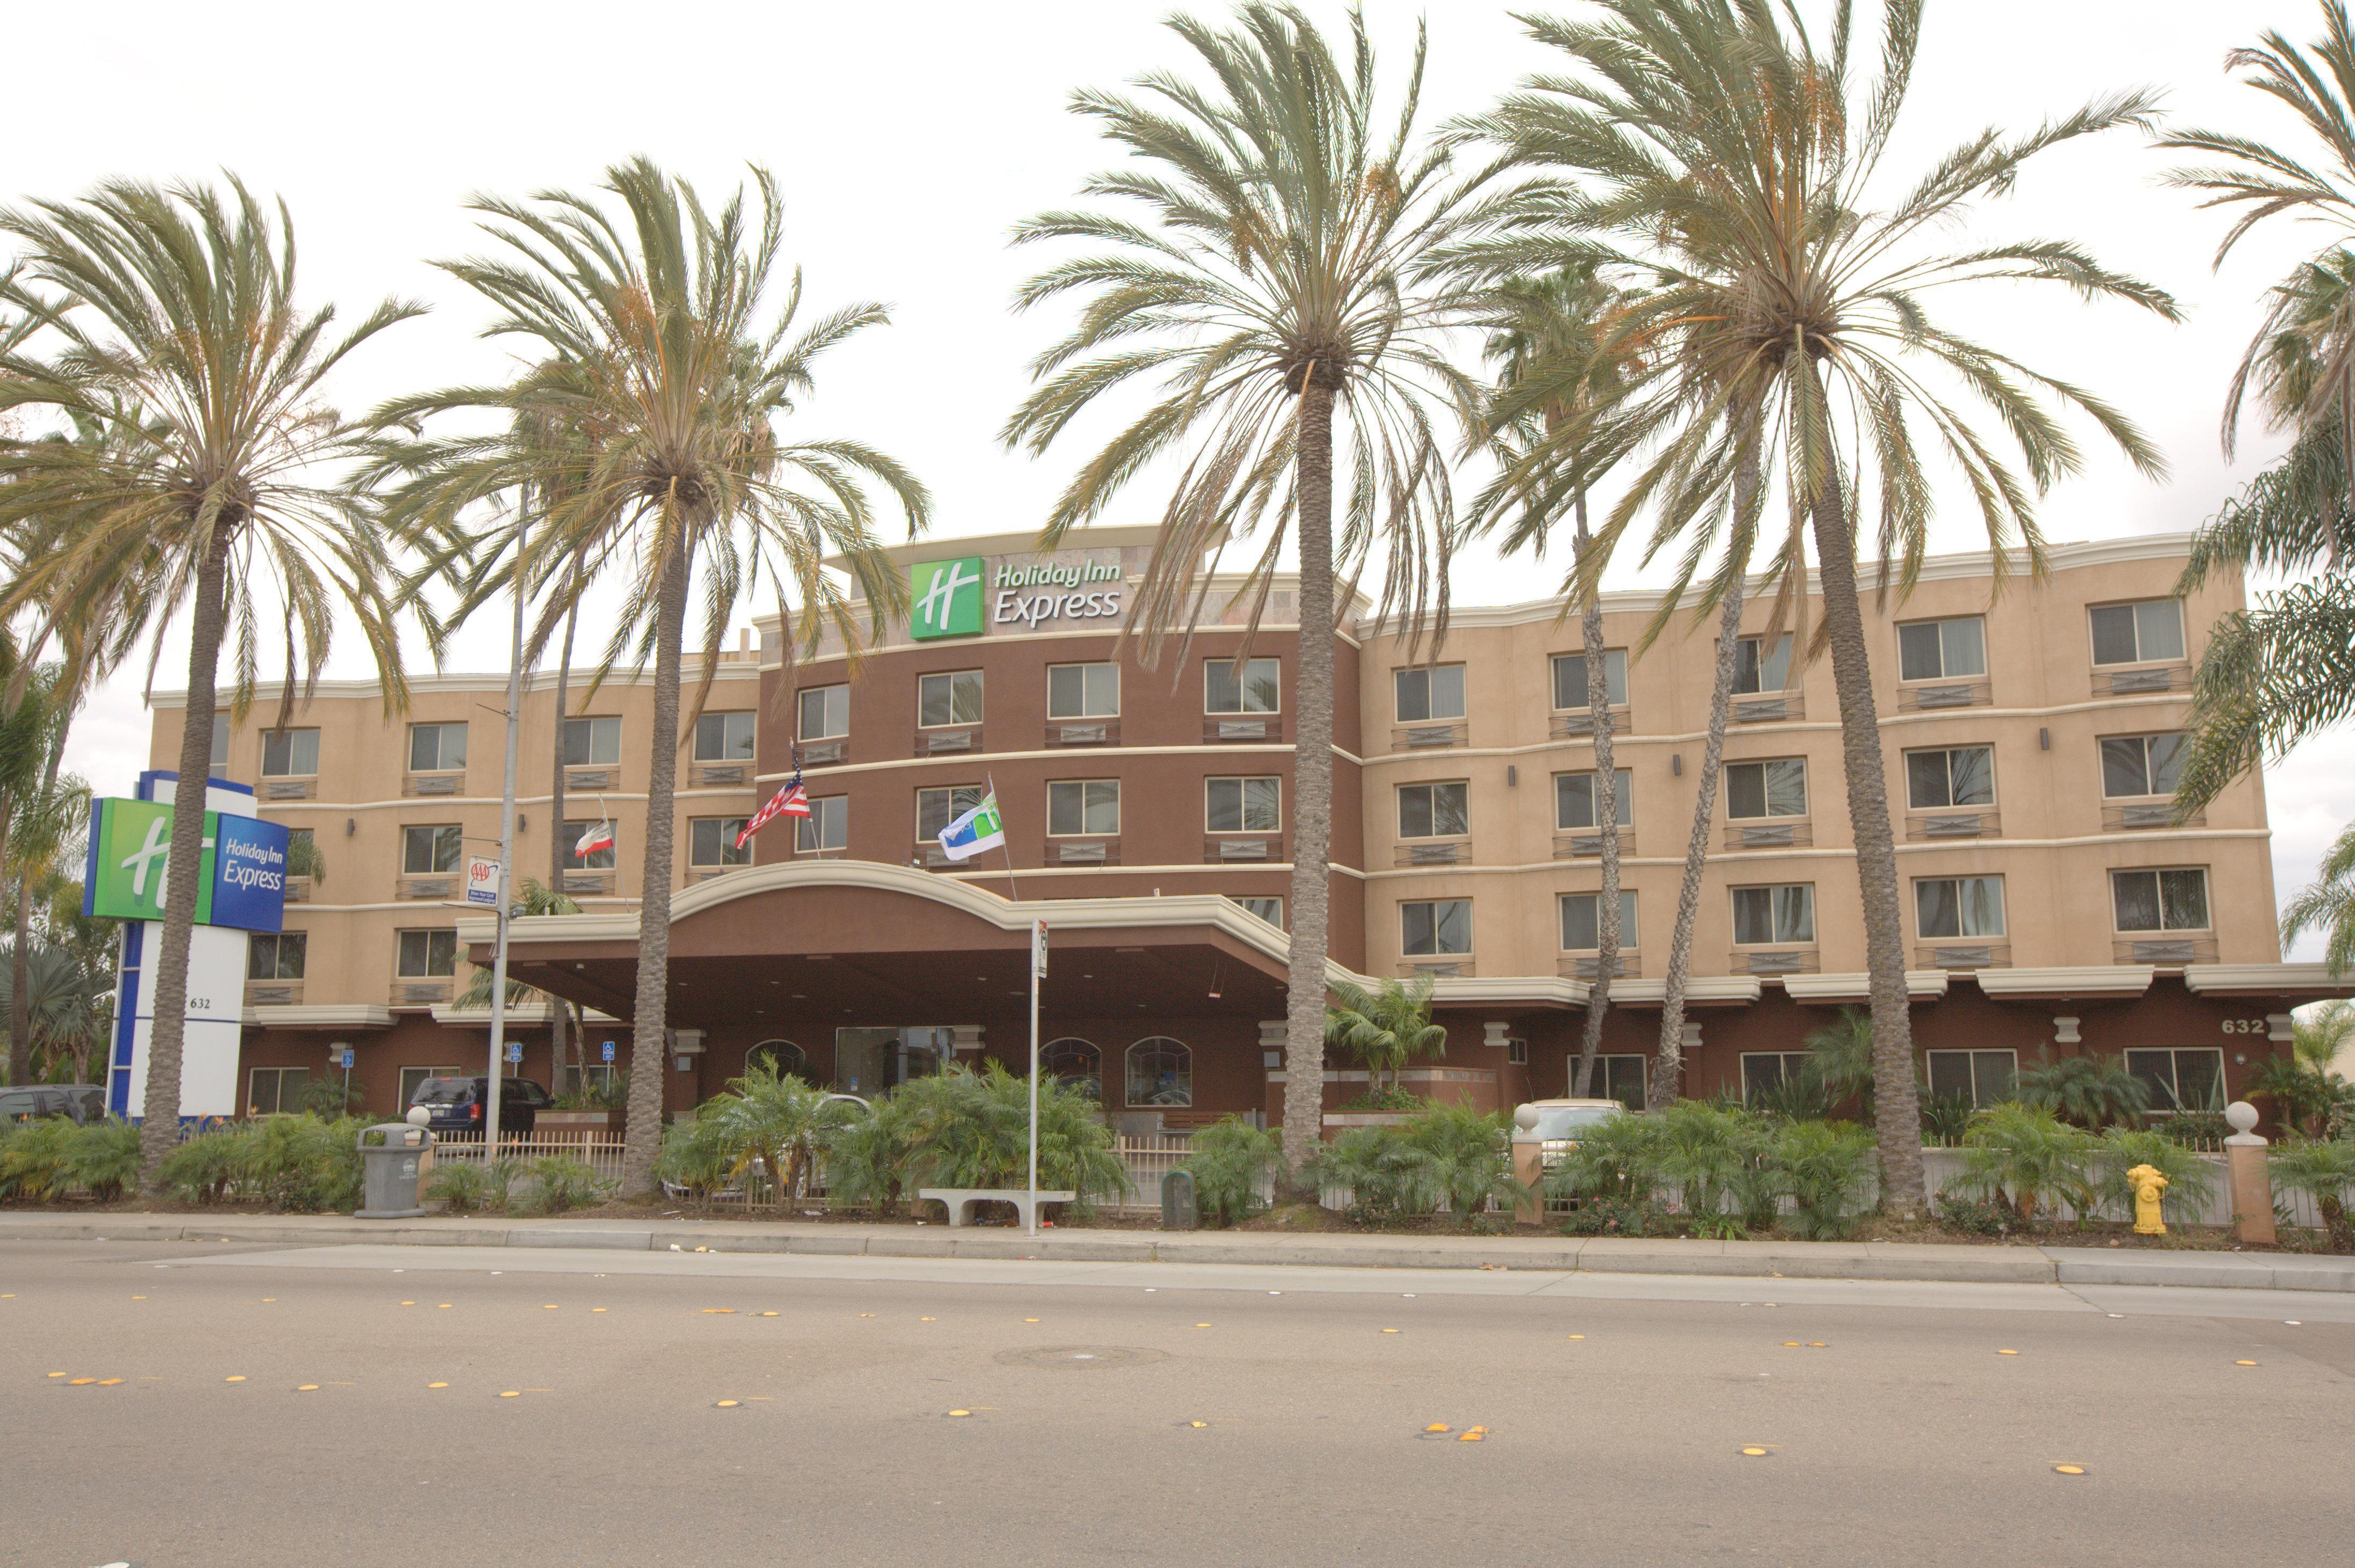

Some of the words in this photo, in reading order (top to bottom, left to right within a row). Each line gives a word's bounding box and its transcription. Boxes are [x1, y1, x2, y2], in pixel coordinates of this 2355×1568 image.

[994, 562, 1081, 589] Holiday
[1084, 558, 1120, 581] Inn
[993, 590, 1121, 629] Express
[226, 838, 268, 865] Holiday
[268, 846, 282, 864] Inn
[224, 859, 281, 890] Express
[471, 862, 489, 881] AAA
[191, 998, 210, 1008] 632
[2222, 1020, 2264, 1034] 632
